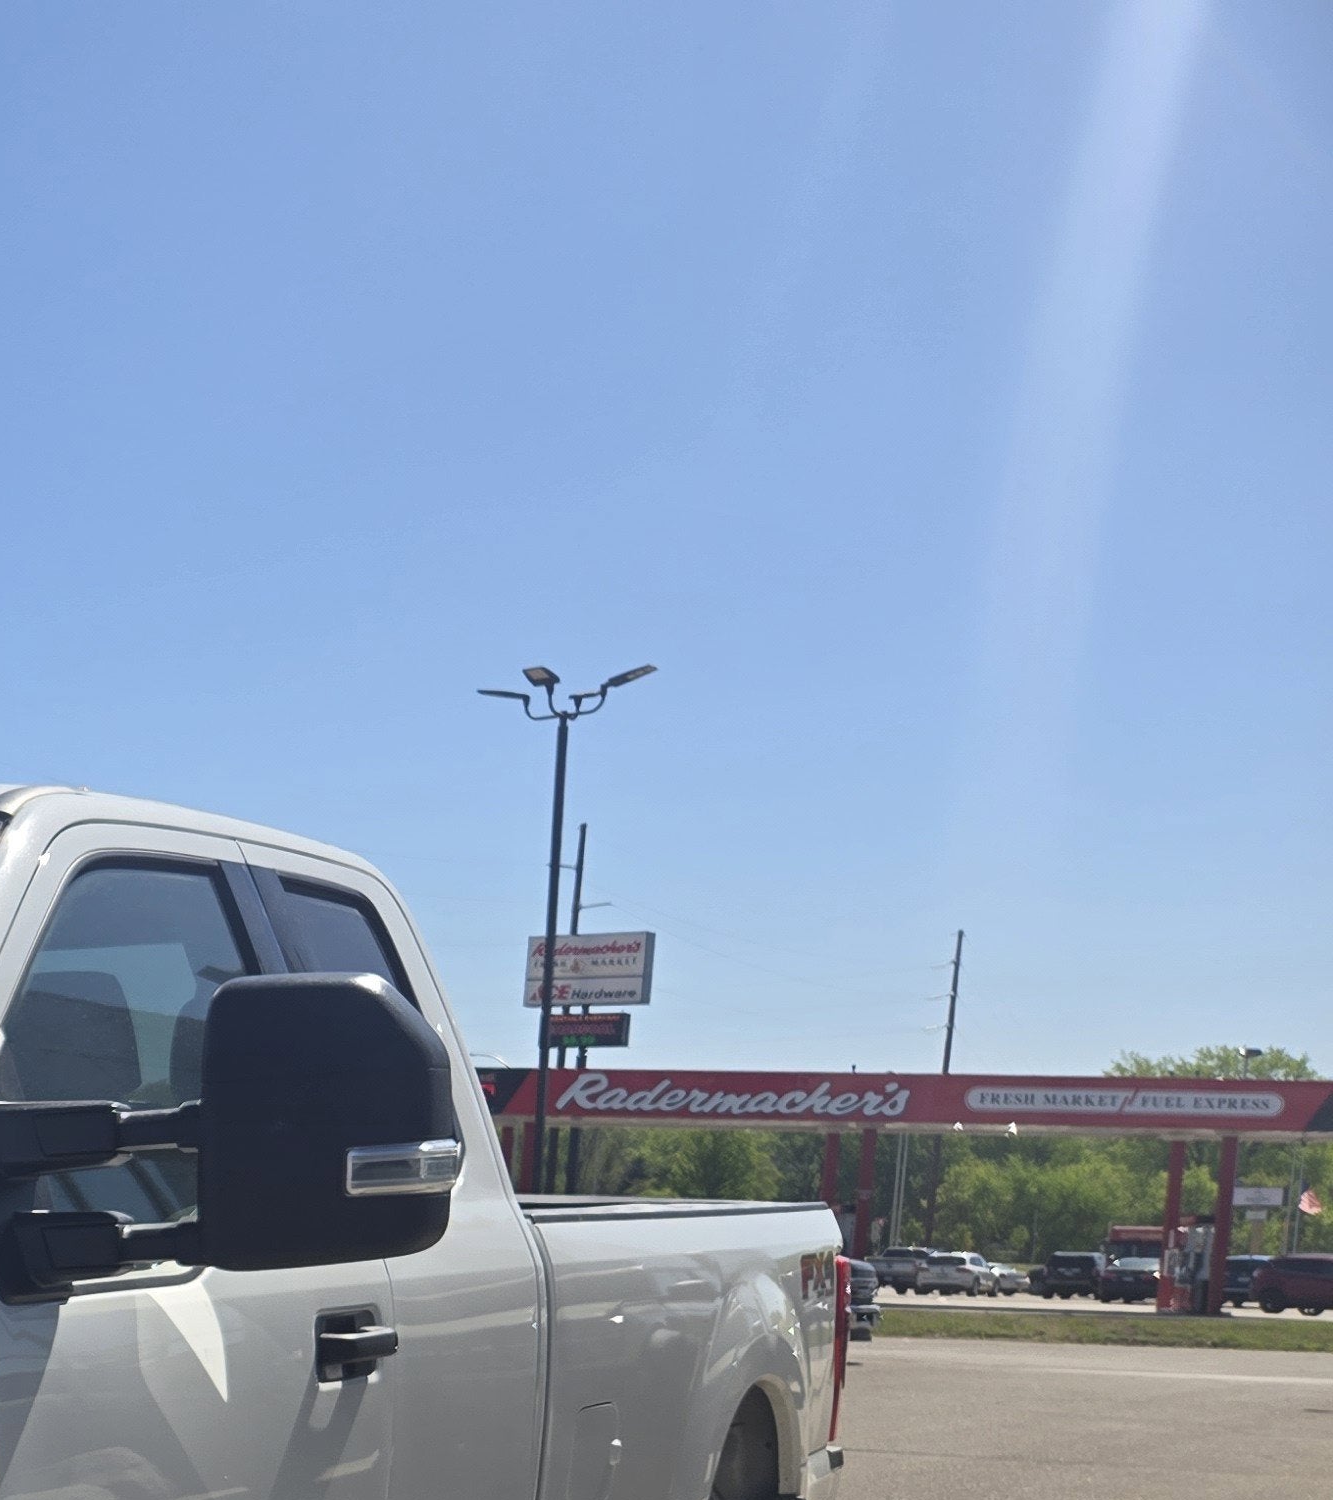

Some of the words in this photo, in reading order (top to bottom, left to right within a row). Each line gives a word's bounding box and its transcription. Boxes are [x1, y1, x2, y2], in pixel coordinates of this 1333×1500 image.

[531, 939, 641, 958] Rdermacher's
[534, 960, 567, 968] FRSH
[591, 957, 638, 966] MARKET
[571, 988, 636, 1000] Hardware
[556, 1073, 910, 1116] Radermacher's
[979, 1091, 1035, 1106] FRESH
[1043, 1093, 1118, 1108] MARKET
[1140, 1095, 1186, 1110] FUEL
[1192, 1097, 1272, 1111] EXPRESS
